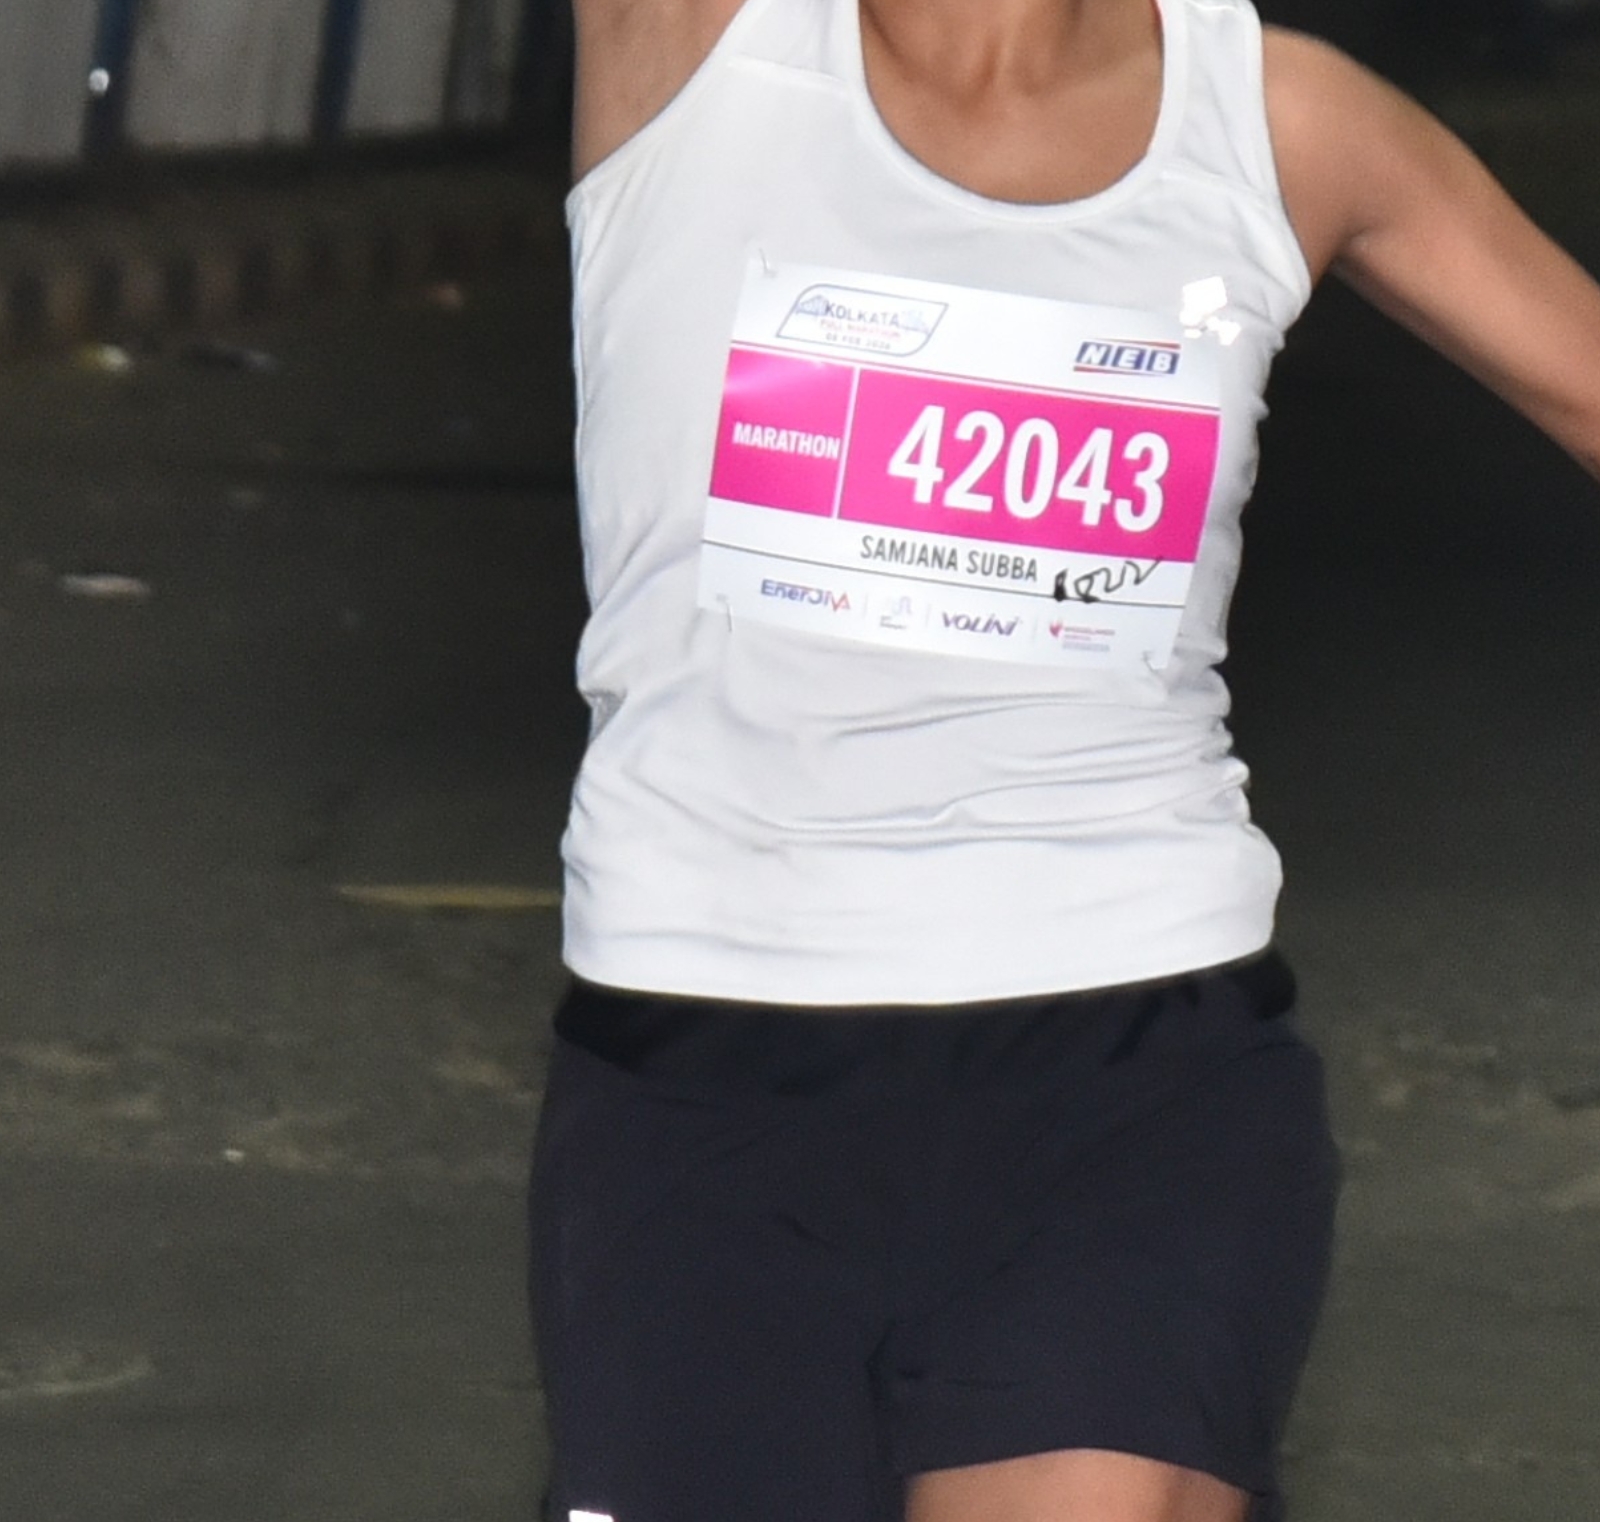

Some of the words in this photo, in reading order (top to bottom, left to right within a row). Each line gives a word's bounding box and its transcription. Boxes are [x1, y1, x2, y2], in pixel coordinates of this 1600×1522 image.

[824, 302, 900, 328] KOLKATA
[1079, 343, 1174, 374] NEB
[731, 421, 841, 460] MARATHON
[886, 404, 1170, 533] 42043
[860, 535, 958, 571] SAMJANA
[965, 549, 1038, 583] SUBBA
